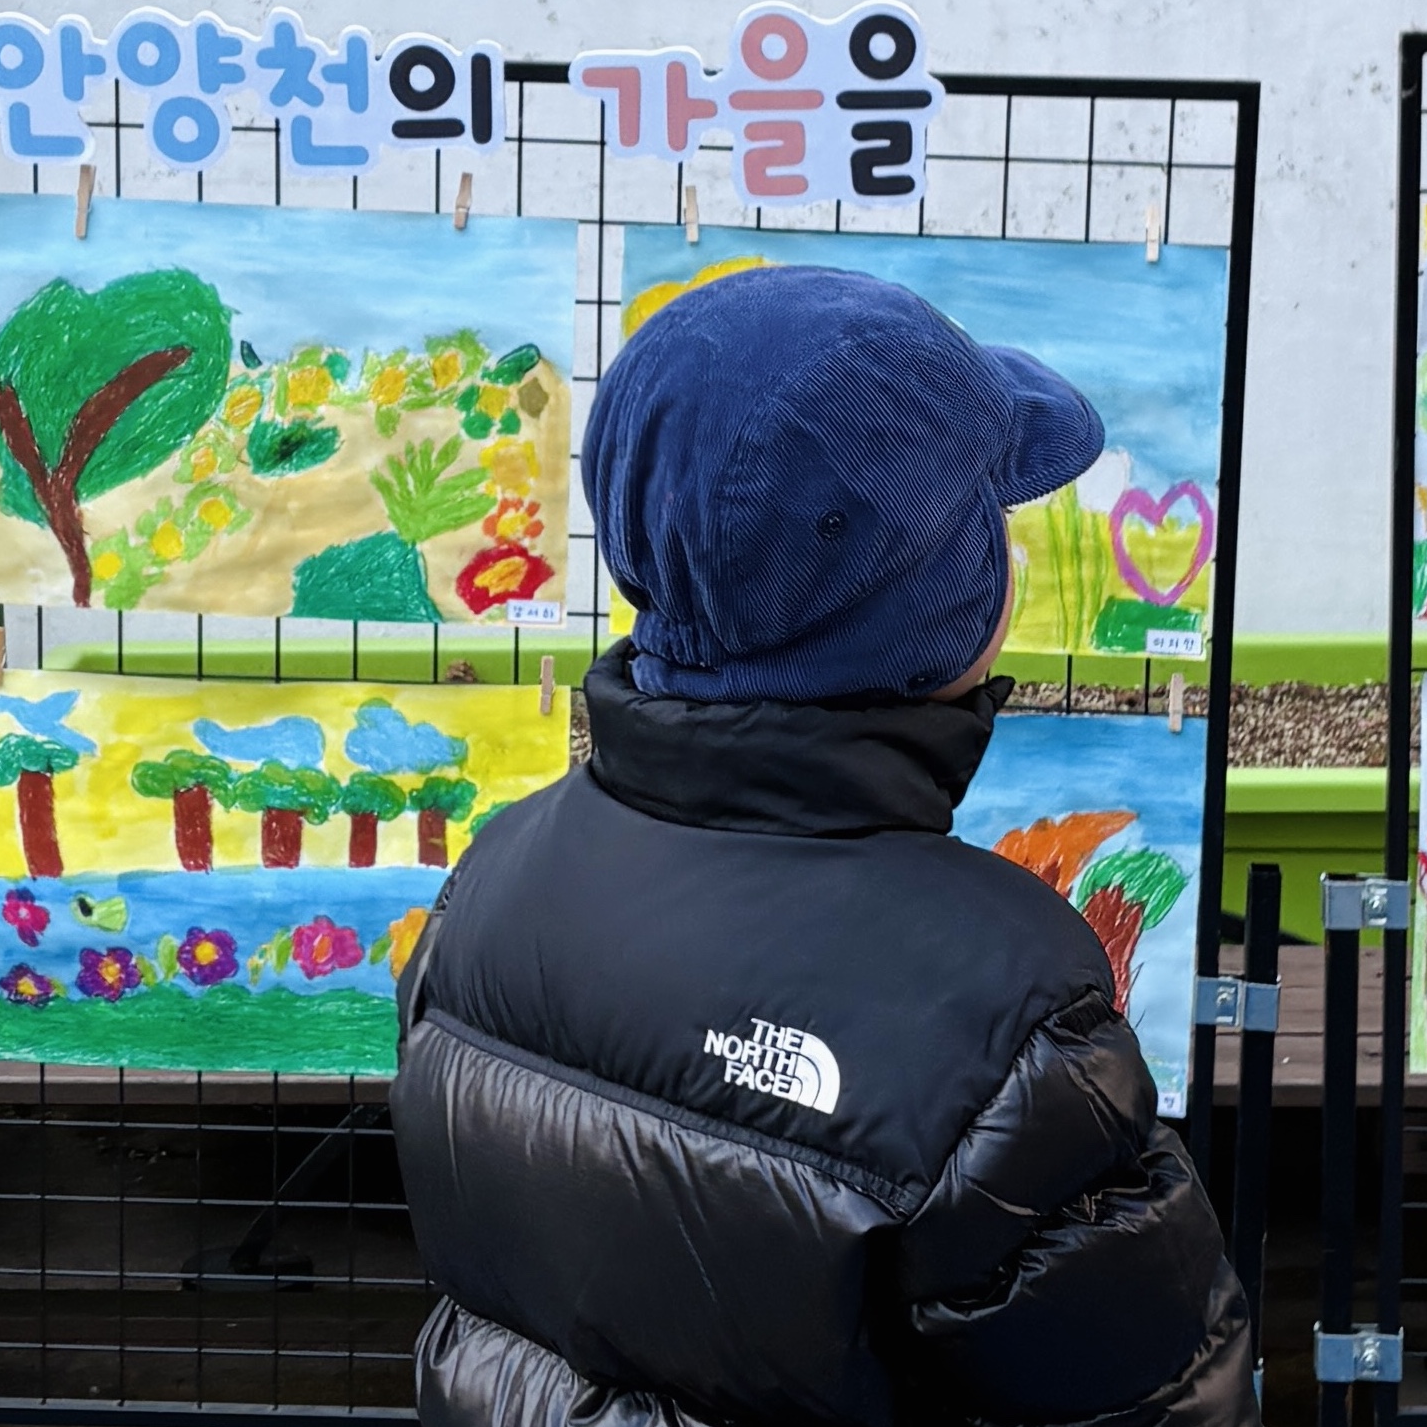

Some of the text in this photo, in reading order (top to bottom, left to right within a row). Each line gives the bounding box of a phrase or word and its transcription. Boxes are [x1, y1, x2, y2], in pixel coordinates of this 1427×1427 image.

[581, 12, 934, 197] 가을을
[703, 1028, 798, 1077] NORTH
[750, 1016, 804, 1053] THE
[724, 1059, 794, 1099] FACE
